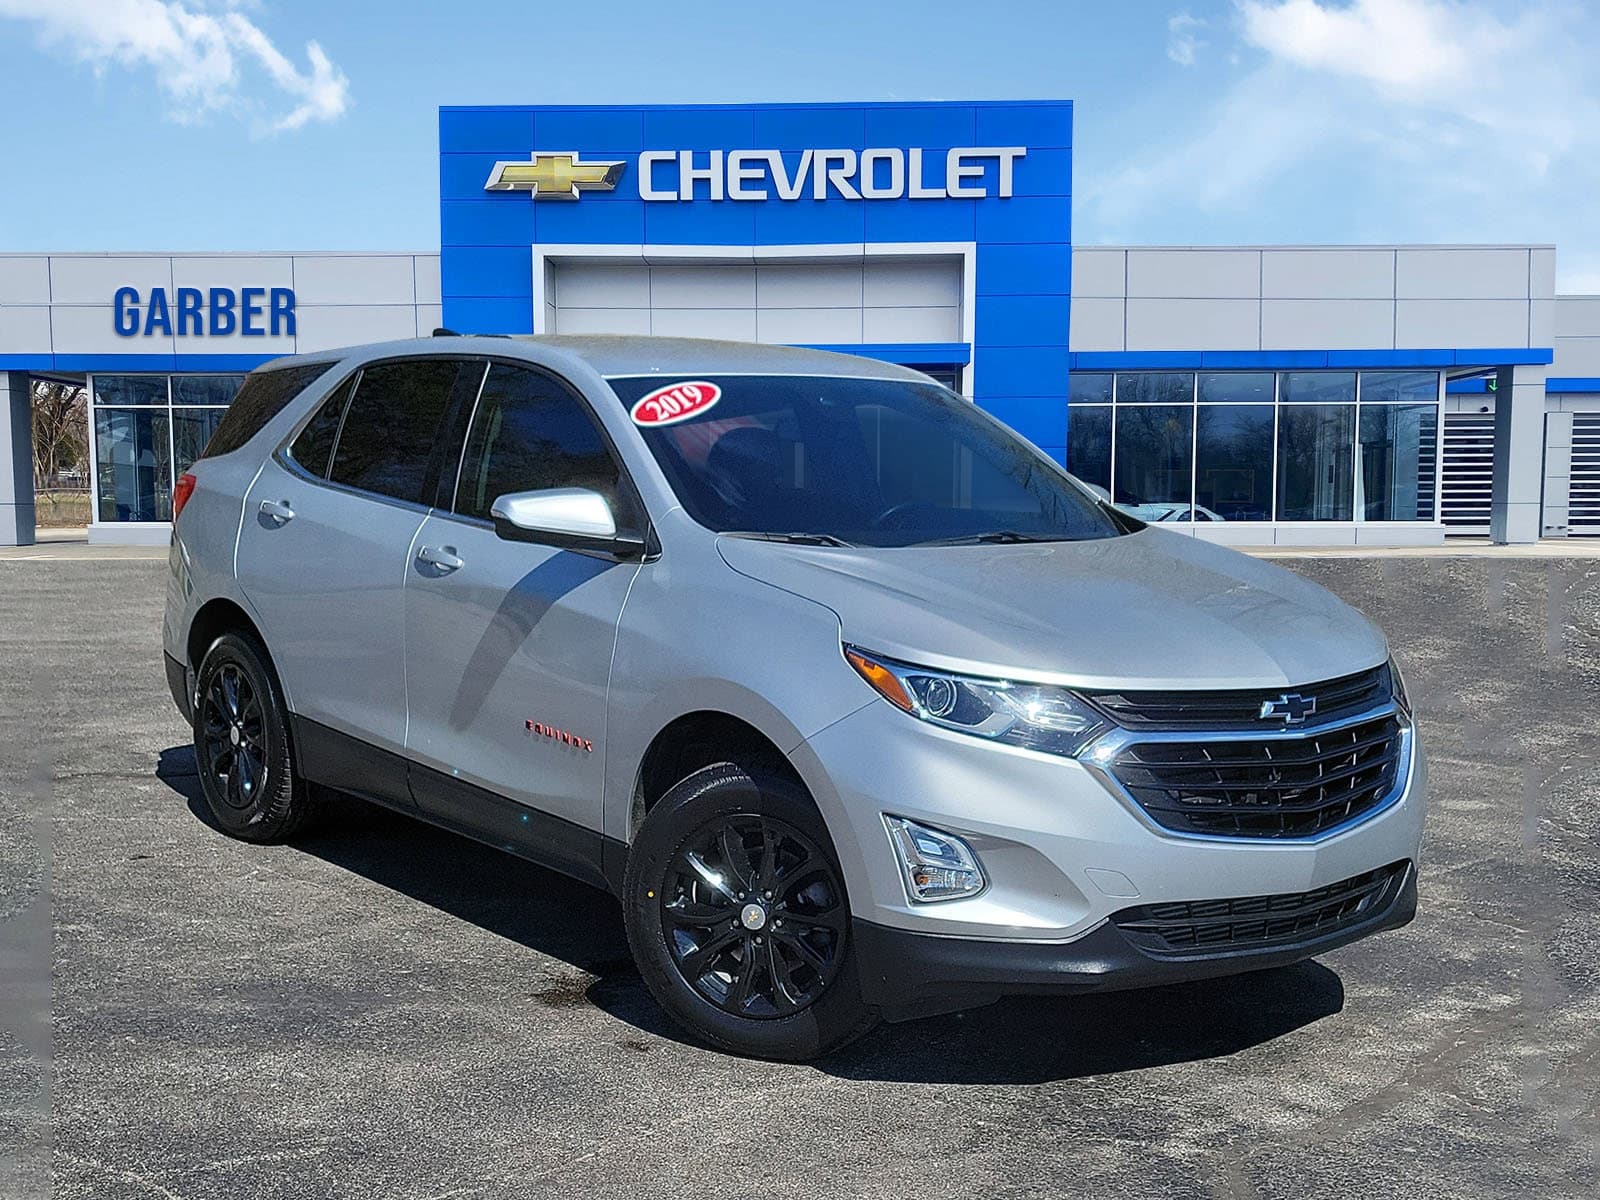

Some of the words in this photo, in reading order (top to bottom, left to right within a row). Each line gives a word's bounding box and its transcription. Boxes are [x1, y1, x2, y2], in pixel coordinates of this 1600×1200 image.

[638, 146, 1027, 201] CHEVROLET
[114, 286, 297, 336] GARBER
[645, 384, 702, 421] 2019
[525, 719, 593, 753] EQUINOX
